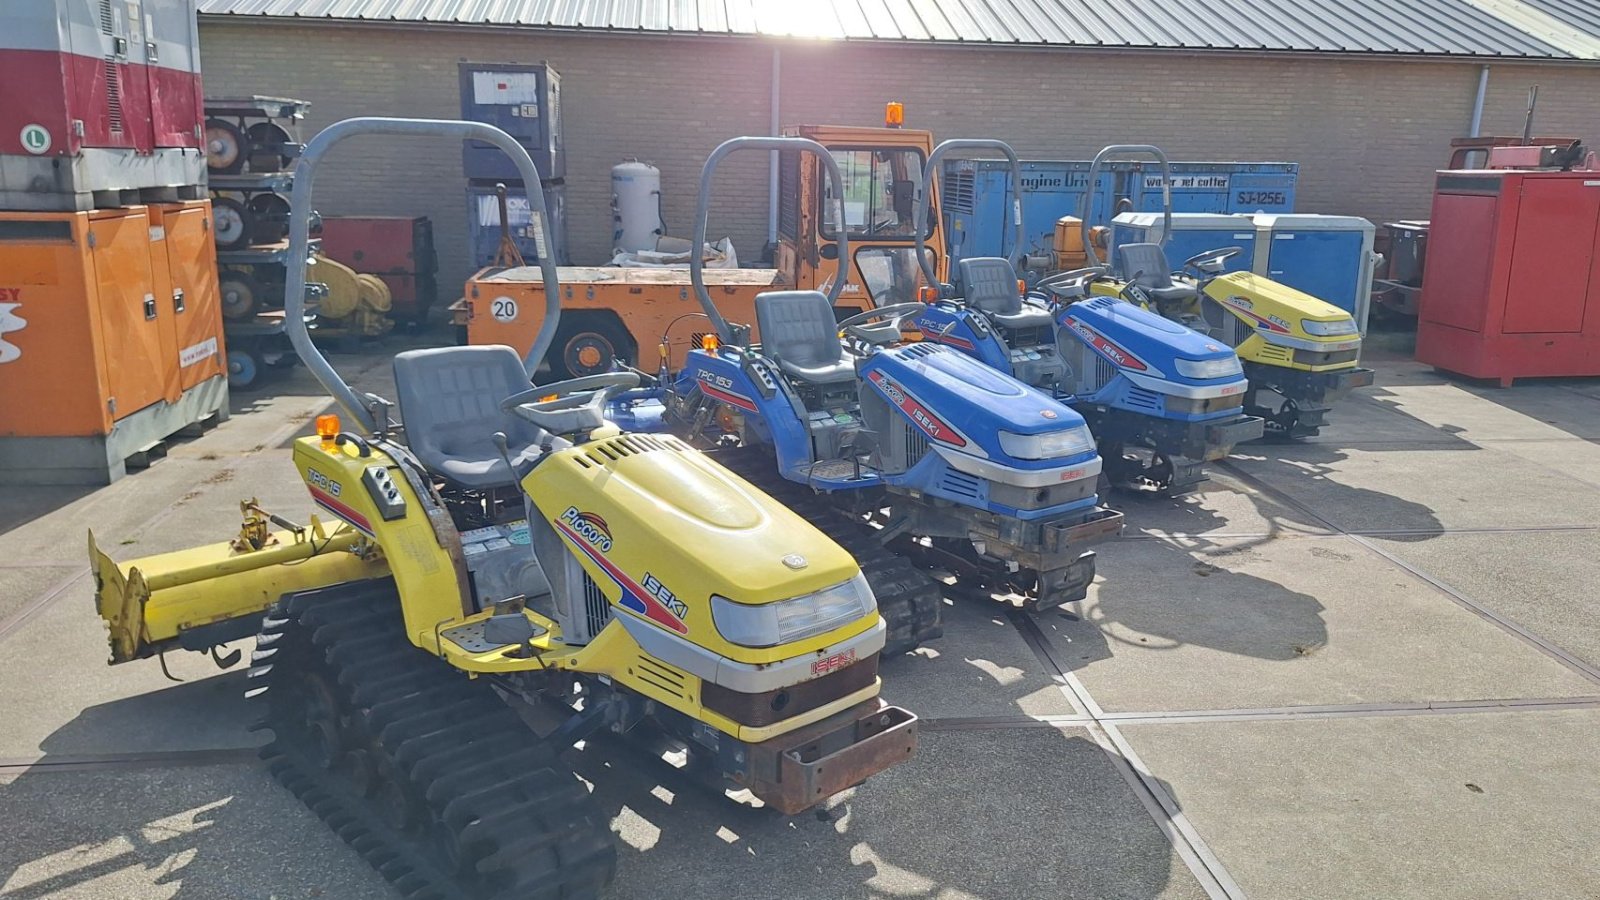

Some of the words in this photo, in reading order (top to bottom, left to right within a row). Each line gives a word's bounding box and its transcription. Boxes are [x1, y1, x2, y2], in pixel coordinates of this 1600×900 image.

[31, 130, 42, 147] L
[1012, 174, 1061, 190] ngine
[1146, 178, 1177, 187] waer
[494, 301, 515, 317] 20
[920, 318, 937, 329] TPC
[1101, 343, 1126, 364] ISEKI
[697, 368, 715, 382] TPC
[715, 375, 733, 389] 153
[879, 377, 905, 406] Piccoro
[912, 408, 940, 436] ISEKI
[308, 466, 328, 489] TPC
[329, 479, 342, 497] 15
[561, 505, 613, 553] Piccoro
[641, 571, 689, 620] ISEKI
[810, 647, 857, 675] ISEKI
